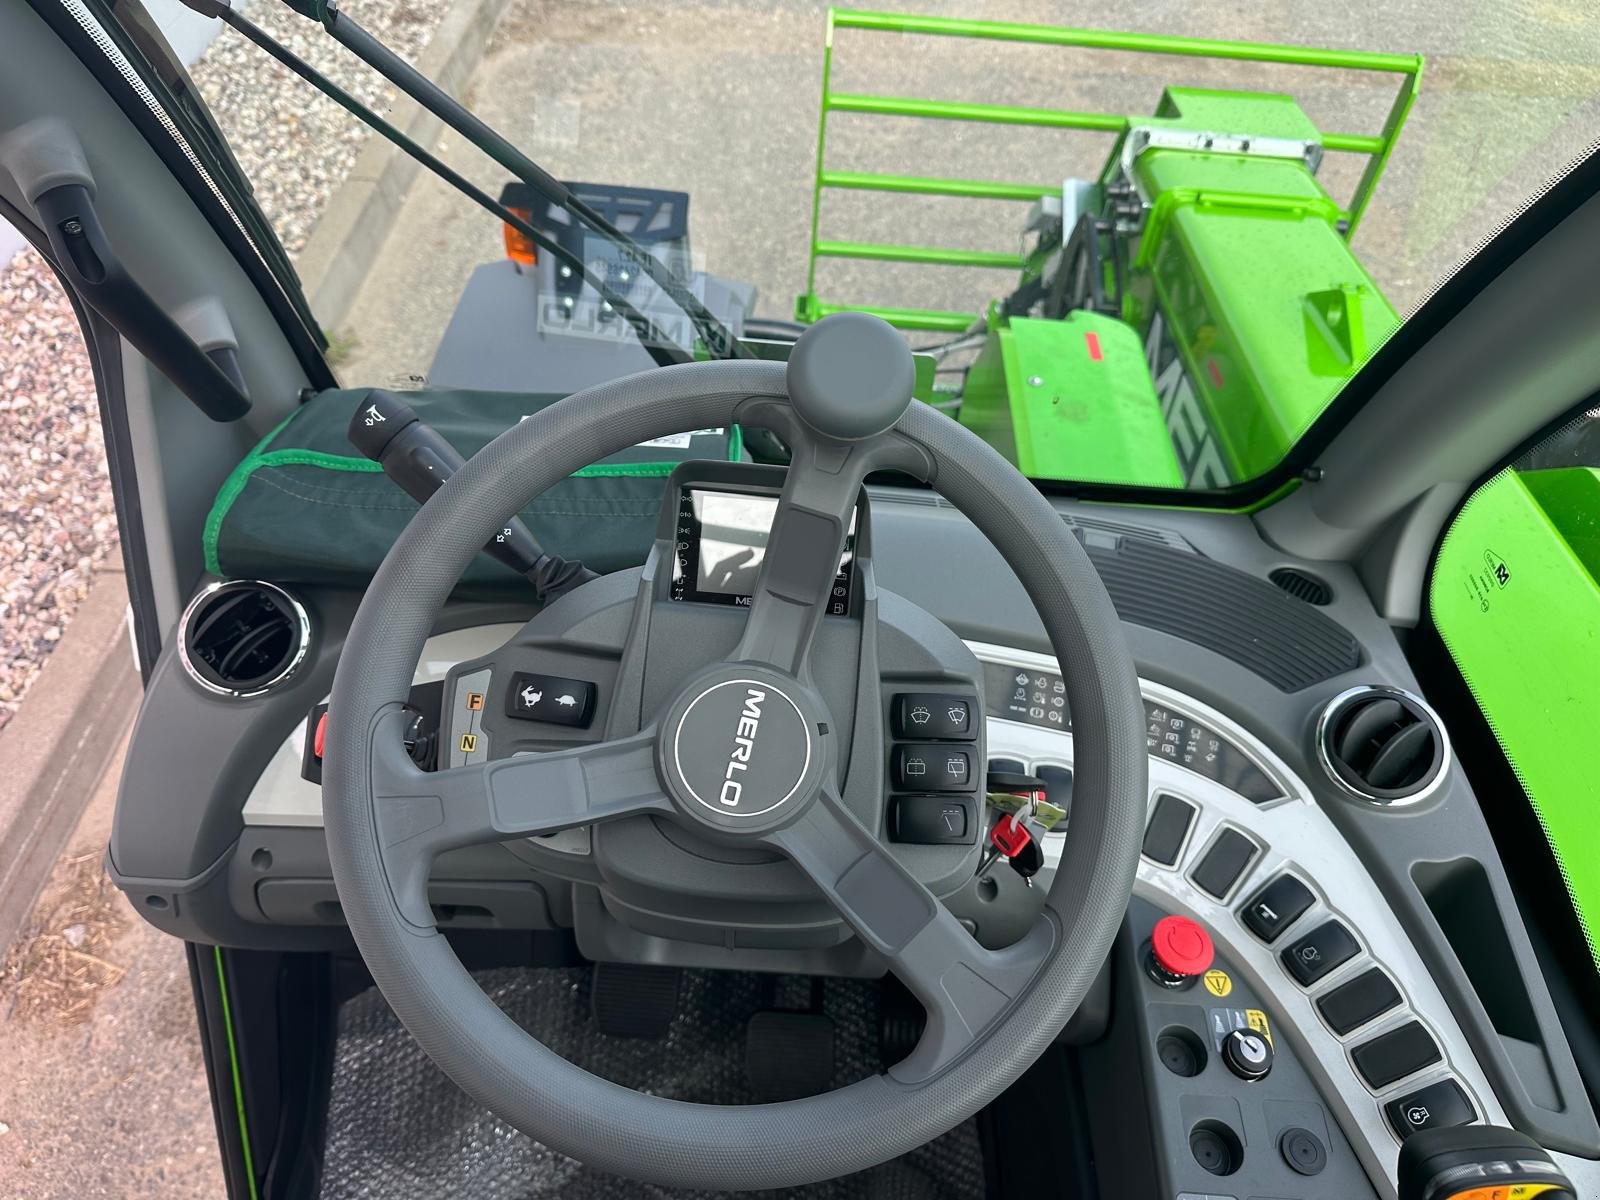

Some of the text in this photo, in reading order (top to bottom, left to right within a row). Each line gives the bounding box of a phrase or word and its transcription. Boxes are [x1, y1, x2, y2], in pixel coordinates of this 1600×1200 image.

[469, 694, 481, 709] F
[462, 735, 475, 750] N
[720, 688, 766, 807] MERLO
